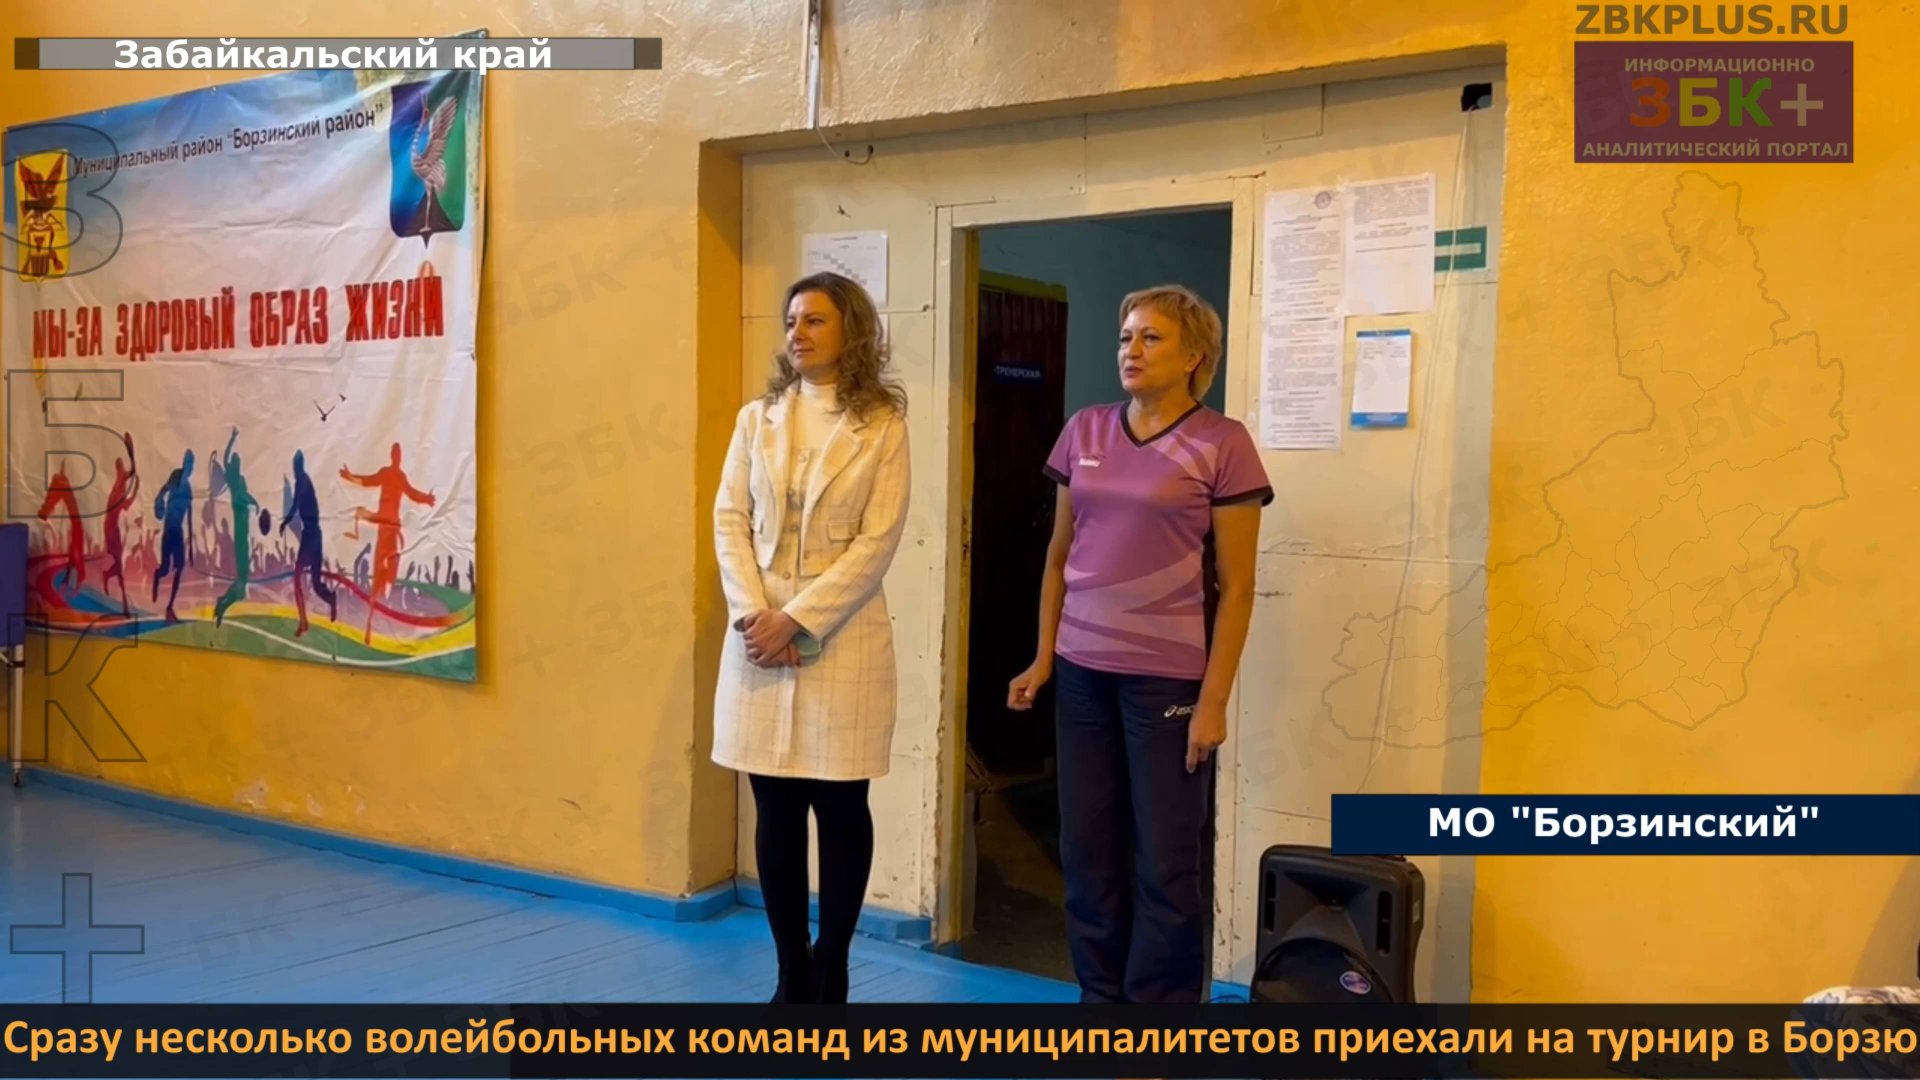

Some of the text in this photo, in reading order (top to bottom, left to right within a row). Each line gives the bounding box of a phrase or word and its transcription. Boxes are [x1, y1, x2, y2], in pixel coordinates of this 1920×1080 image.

[181, 135, 223, 163] район
[115, 286, 236, 362] ЗДОРОВЫЙ
[249, 286, 329, 348] ОБРАЗ
[344, 274, 444, 342] ЖИЗНИ
